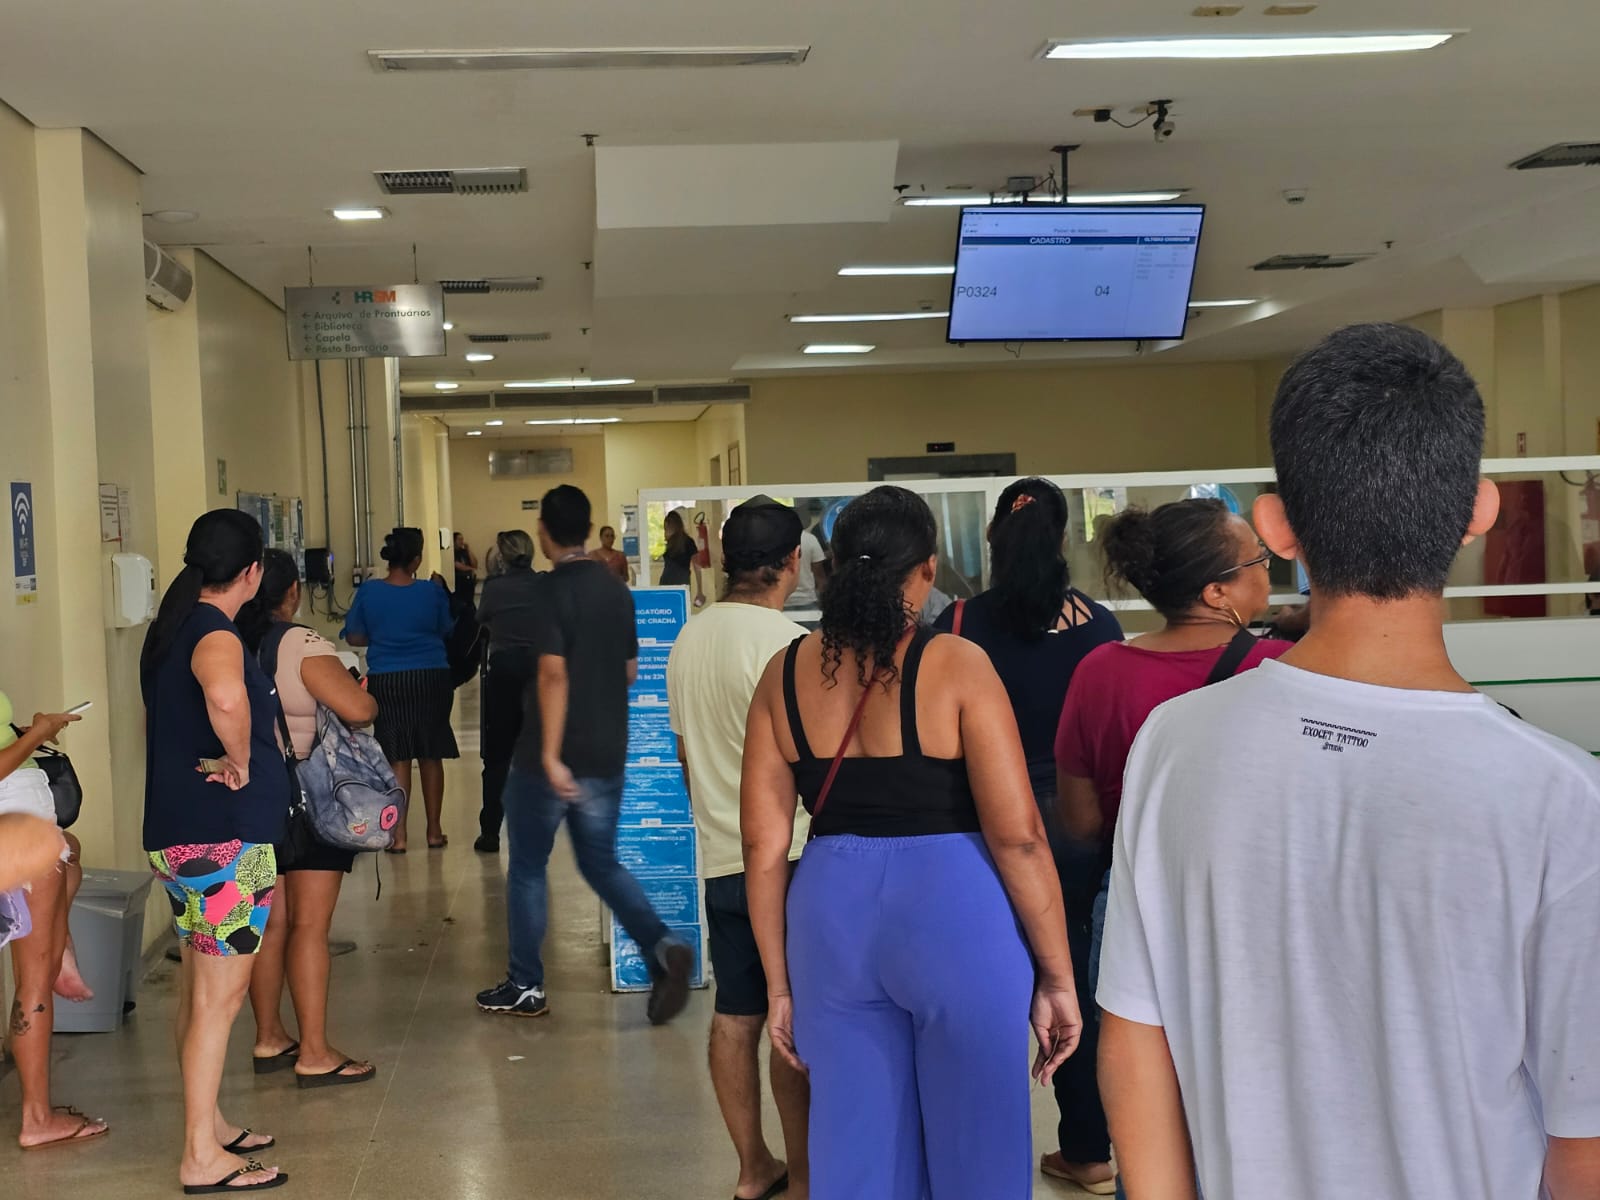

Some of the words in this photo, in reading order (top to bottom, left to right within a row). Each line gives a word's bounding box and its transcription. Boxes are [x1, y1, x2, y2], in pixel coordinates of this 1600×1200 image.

[1029, 236, 1071, 245] CADASTRO
[957, 286, 997, 298] P0324
[1094, 285, 1110, 297] 04
[314, 311, 353, 321] Arquivo
[359, 309, 372, 319] de
[374, 309, 431, 319] Prontuários
[314, 323, 362, 331] Biblioteca
[315, 333, 350, 344] Capela
[316, 344, 342, 353] Posto
[345, 343, 388, 353] Bancário
[1337, 733, 1369, 748] TATTOO
